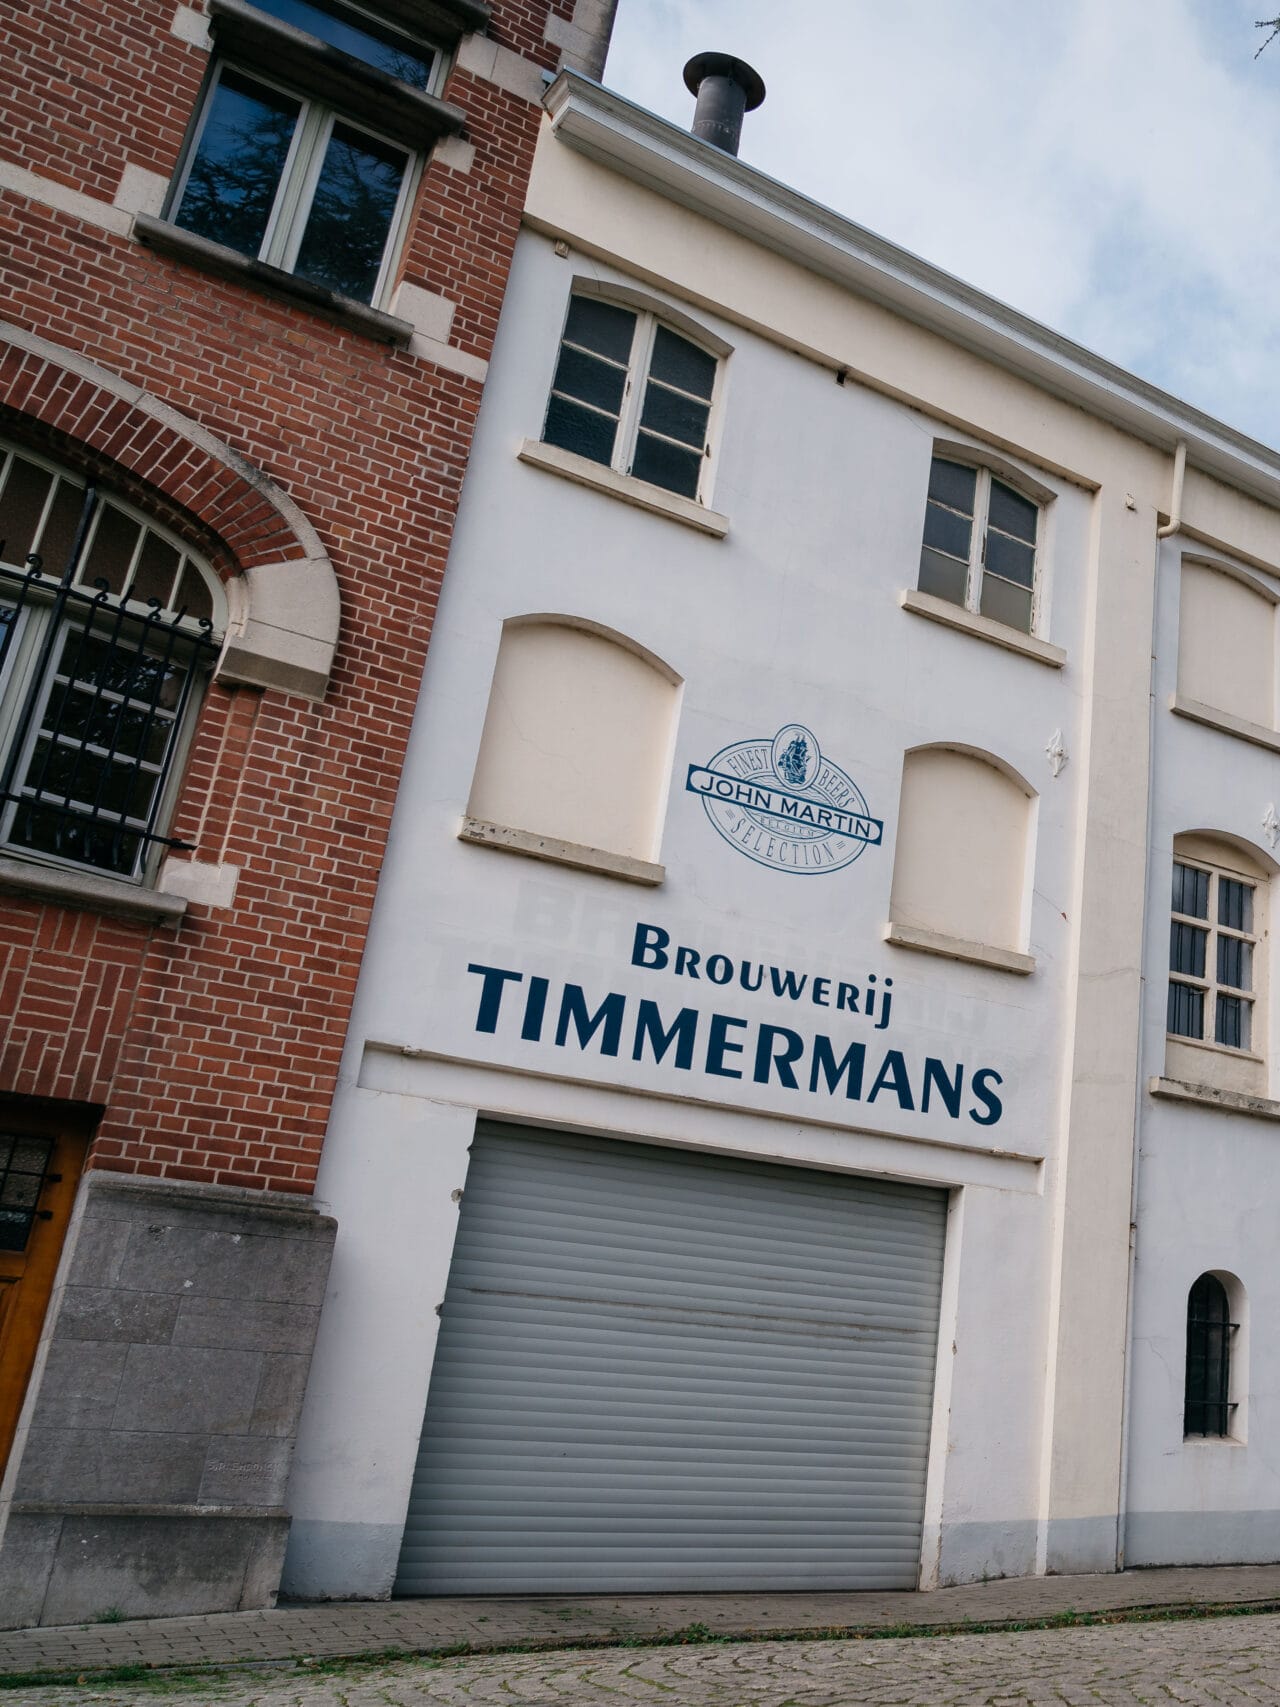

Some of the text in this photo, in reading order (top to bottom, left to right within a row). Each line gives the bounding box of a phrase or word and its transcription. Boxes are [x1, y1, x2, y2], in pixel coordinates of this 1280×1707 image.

[700, 775, 871, 838] JOHN MARTIN
[727, 749, 855, 808] FINEST BEERS
[730, 818, 836, 865] SELECTION
[467, 963, 1003, 1126] TIMMERMANS
